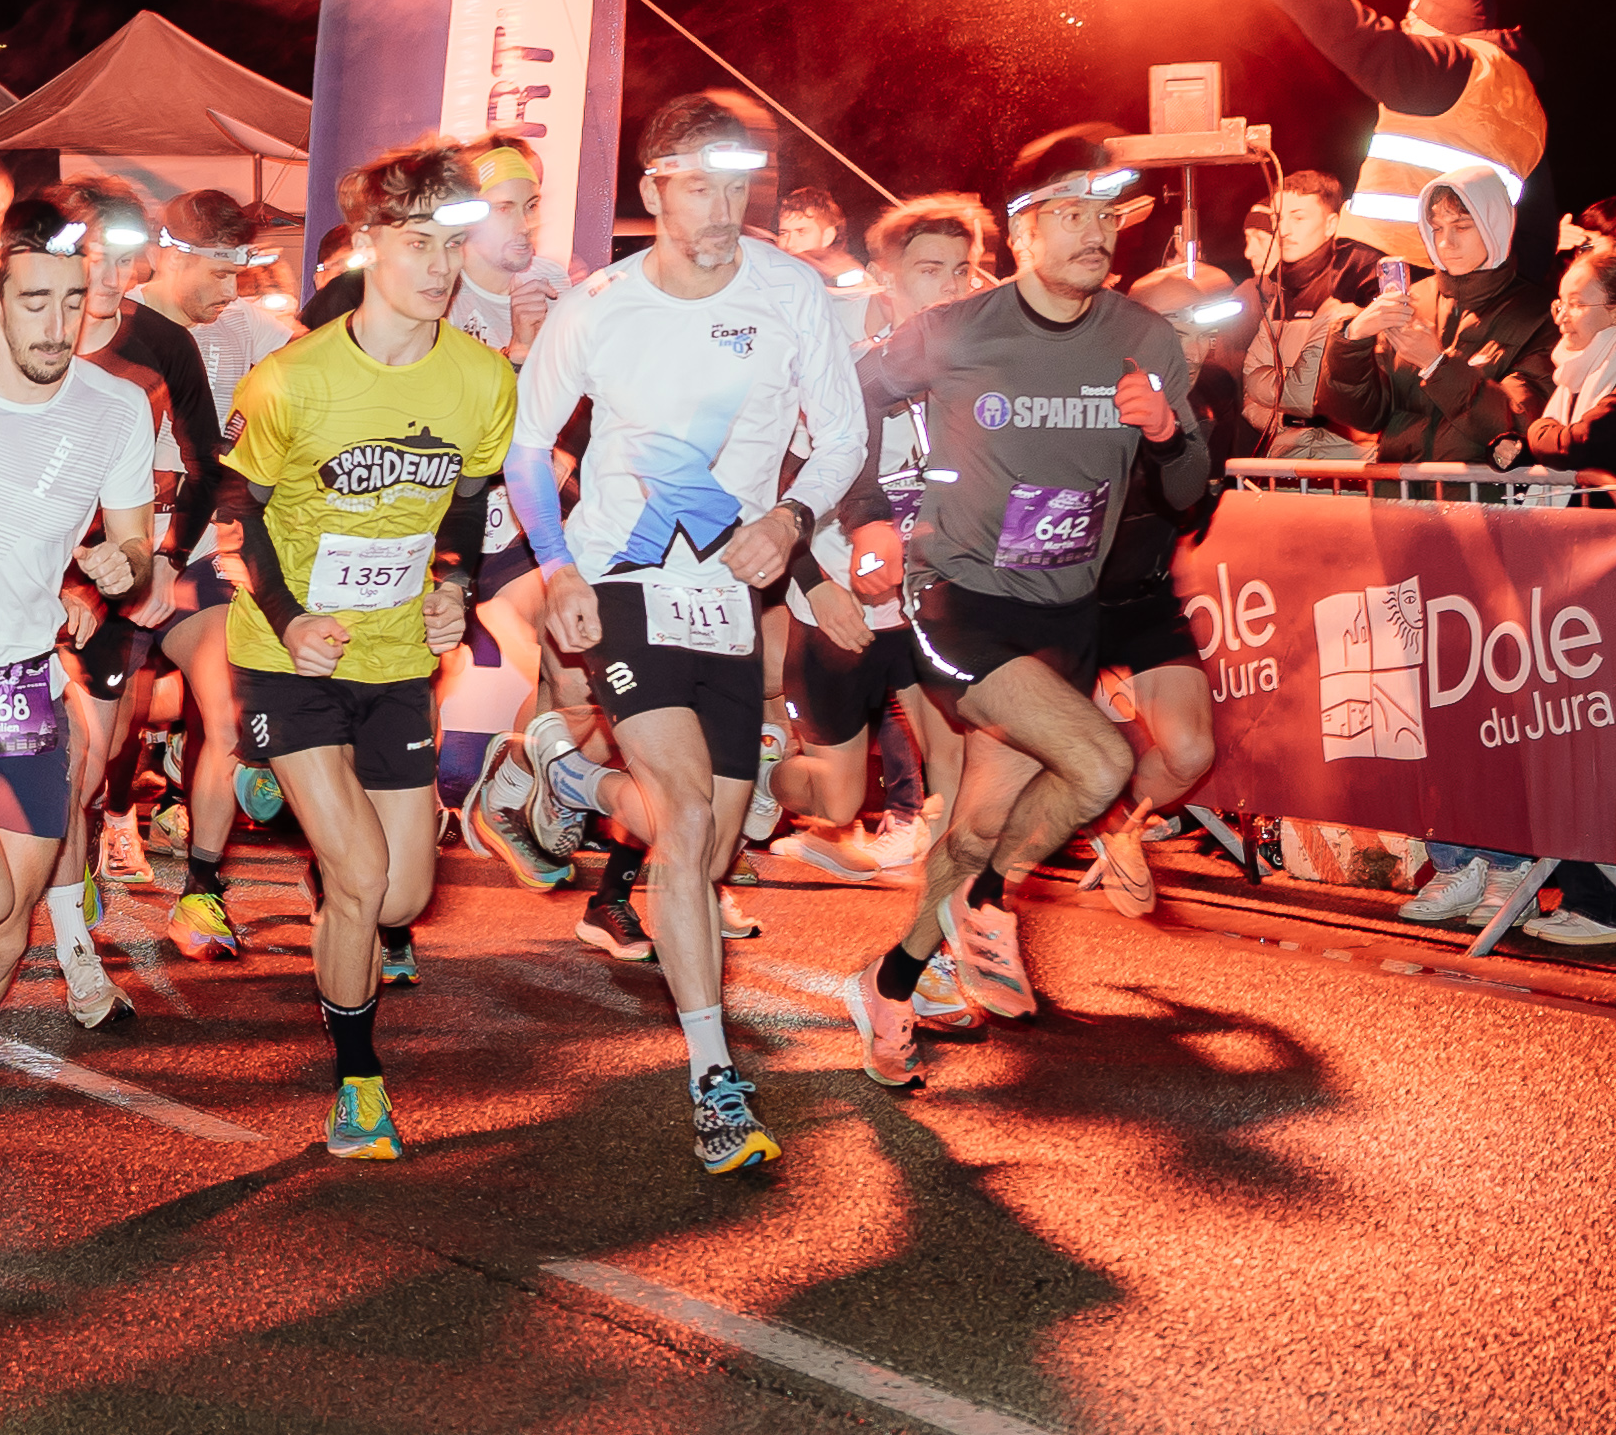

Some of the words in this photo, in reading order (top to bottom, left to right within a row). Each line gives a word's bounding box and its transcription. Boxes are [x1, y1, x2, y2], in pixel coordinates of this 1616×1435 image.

[711, 326, 757, 338] Coach
[32, 435, 74, 498] MILLET
[328, 446, 383, 475] TRAIL
[1035, 515, 1091, 540] 642
[337, 566, 412, 587] 1357
[359, 588, 379, 597] Ugo
[1181, 562, 1277, 661] ole
[1427, 586, 1604, 709] Dole
[1212, 656, 1280, 703] Jura
[1479, 706, 1520, 749] du
[1524, 690, 1616, 741] Jura
